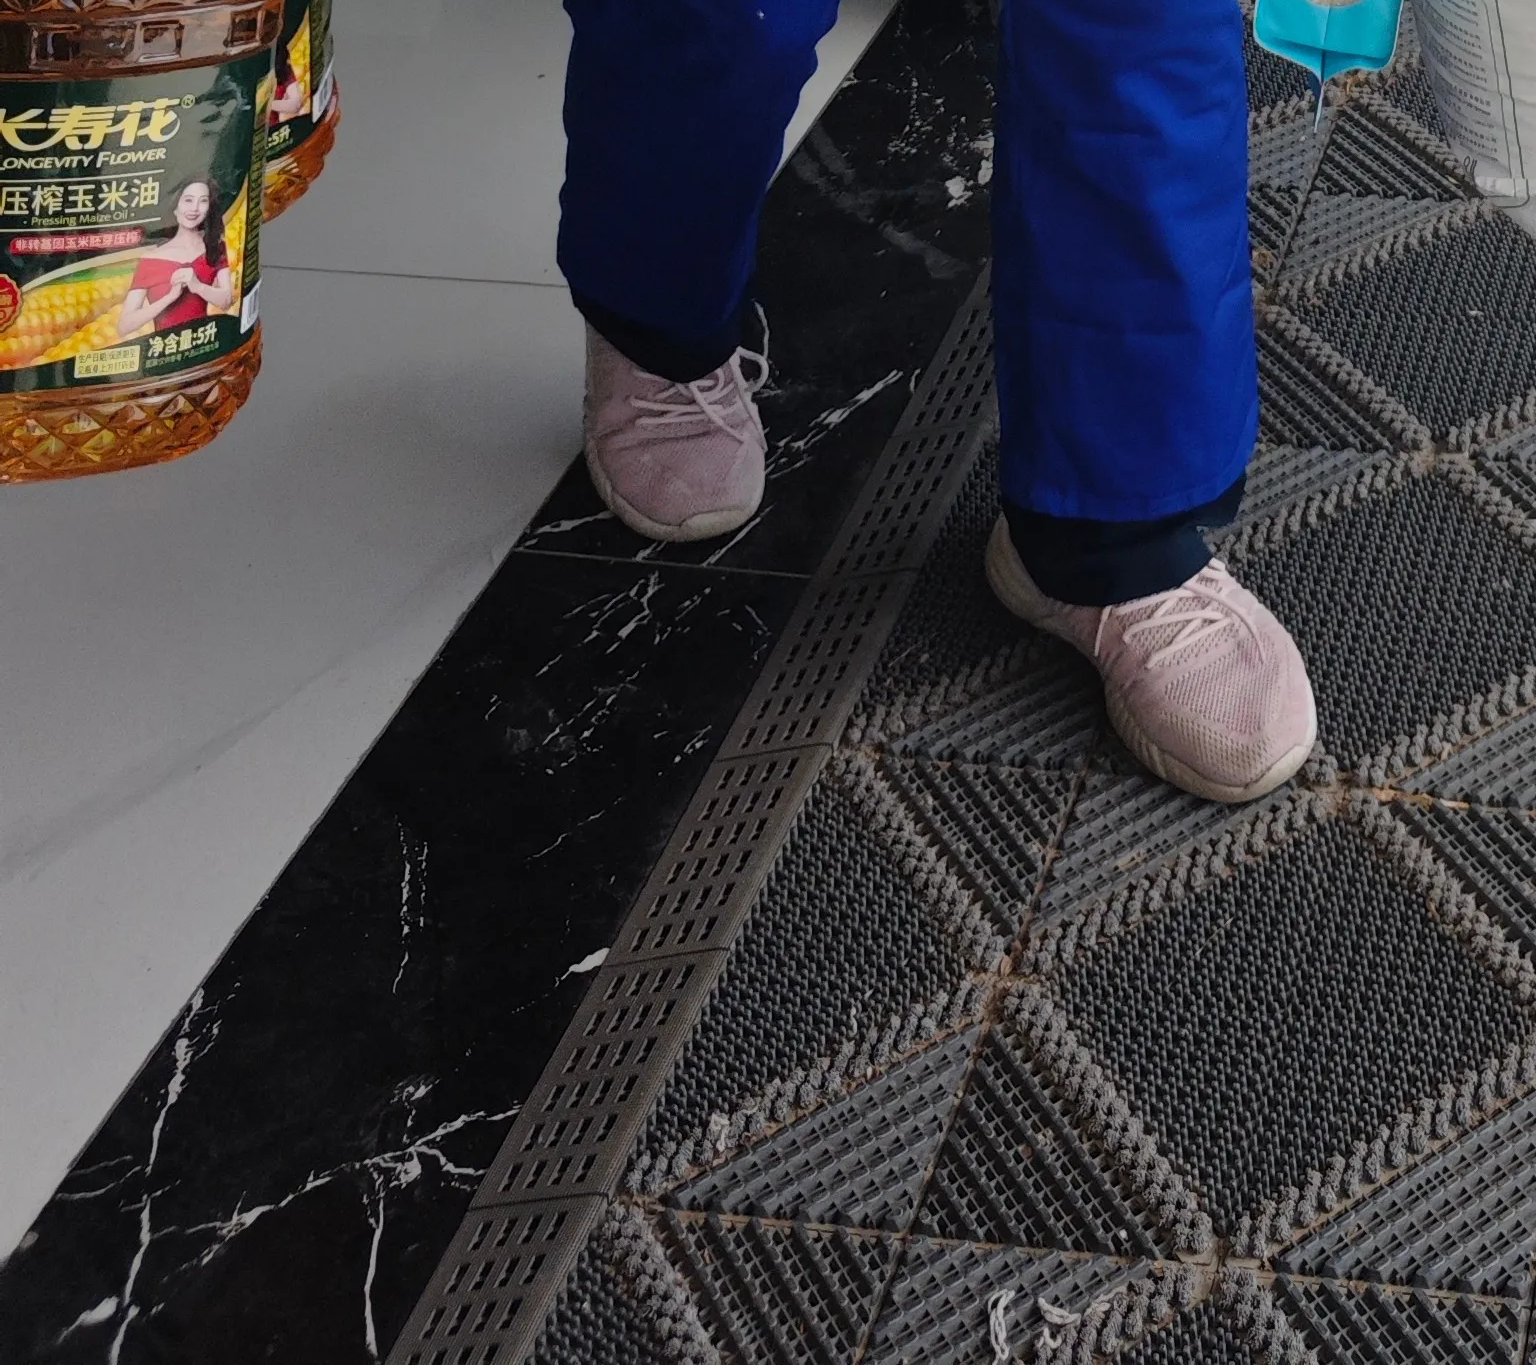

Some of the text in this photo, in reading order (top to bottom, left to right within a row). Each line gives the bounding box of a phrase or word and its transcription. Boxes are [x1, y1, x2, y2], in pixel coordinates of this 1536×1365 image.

[96, 147, 167, 168] FLOWER
[0, 177, 160, 217] 压榨玉米油
[31, 211, 129, 227] Pressing Maize Oil
